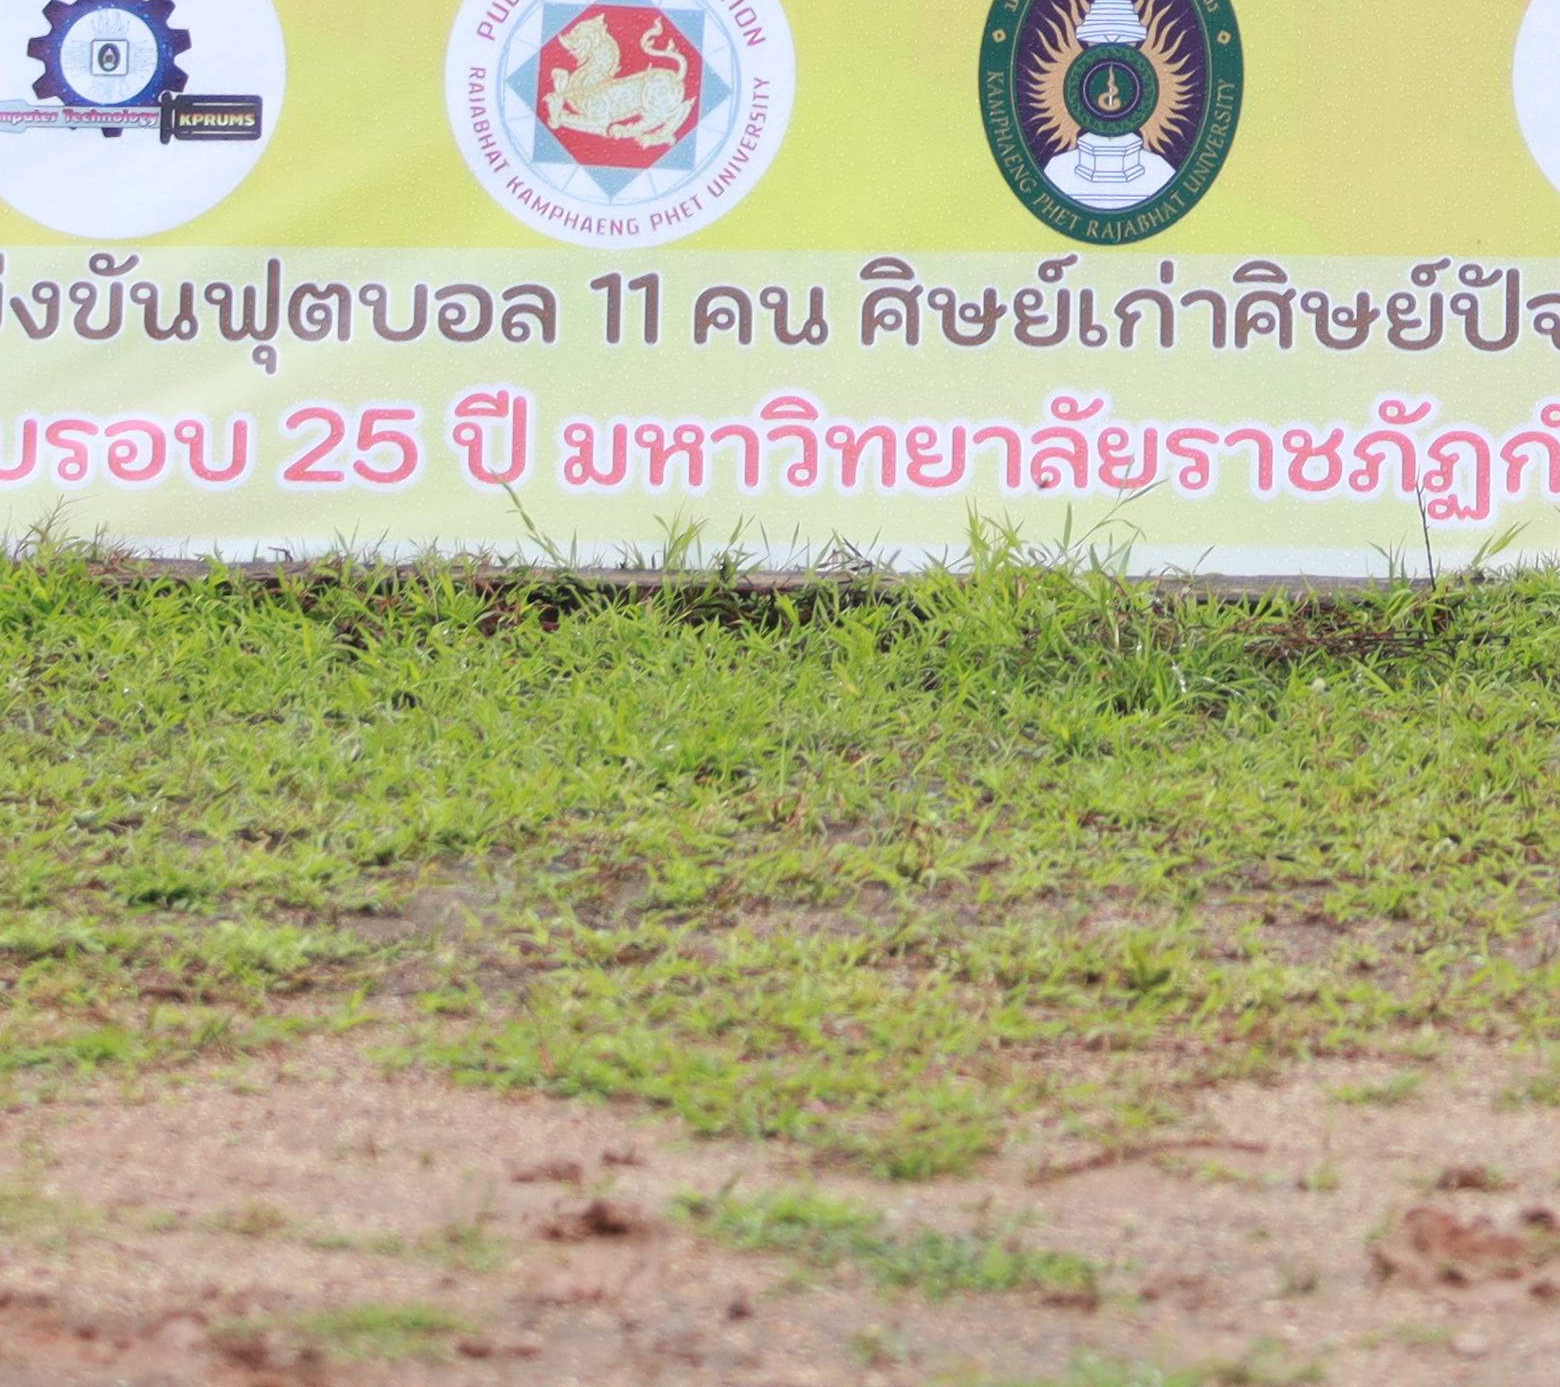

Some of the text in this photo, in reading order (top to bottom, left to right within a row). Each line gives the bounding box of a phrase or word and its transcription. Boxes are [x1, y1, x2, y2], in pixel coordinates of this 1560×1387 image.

[63, 107, 159, 127] Technology
[179, 112, 255, 127] KPRUMS
[468, 66, 771, 236] RAJABHAT KAMPHAENG PHET UNIVERSITY
[986, 70, 1236, 242] KAMPHAENG PHET RAJABHAT UNIVERSITY
[590, 272, 660, 346] 11
[694, 284, 830, 347] คน
[284, 408, 419, 484] 25
[453, 390, 528, 488] ปี
